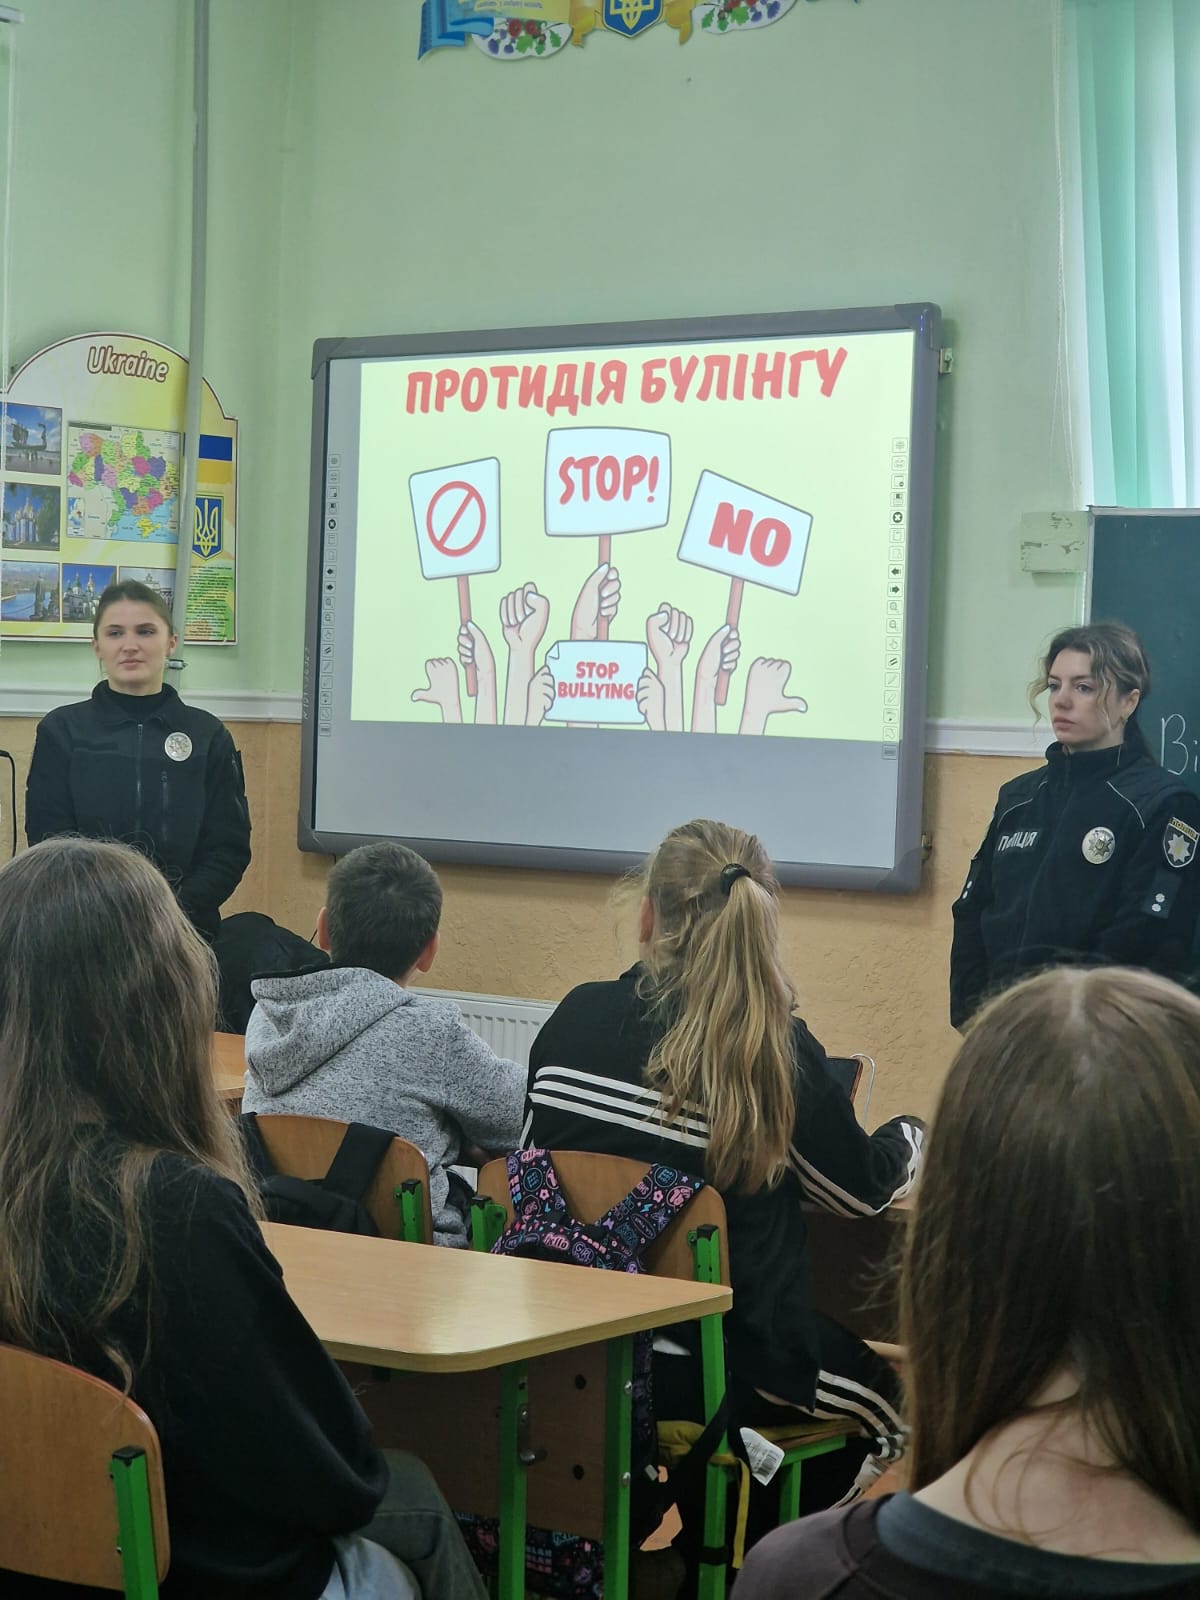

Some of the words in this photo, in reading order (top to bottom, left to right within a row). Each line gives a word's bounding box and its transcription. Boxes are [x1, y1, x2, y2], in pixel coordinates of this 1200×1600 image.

[86, 345, 169, 383] Ukraine
[405, 360, 628, 417] ПРОТИДІЯ
[640, 346, 849, 404] БУЛІНГУ
[558, 454, 660, 505] STOP!
[708, 502, 791, 567] NO
[575, 661, 620, 679] STOP
[557, 681, 635, 700] BULLYING
[997, 831, 1038, 852] ПЛІЦІЯ
